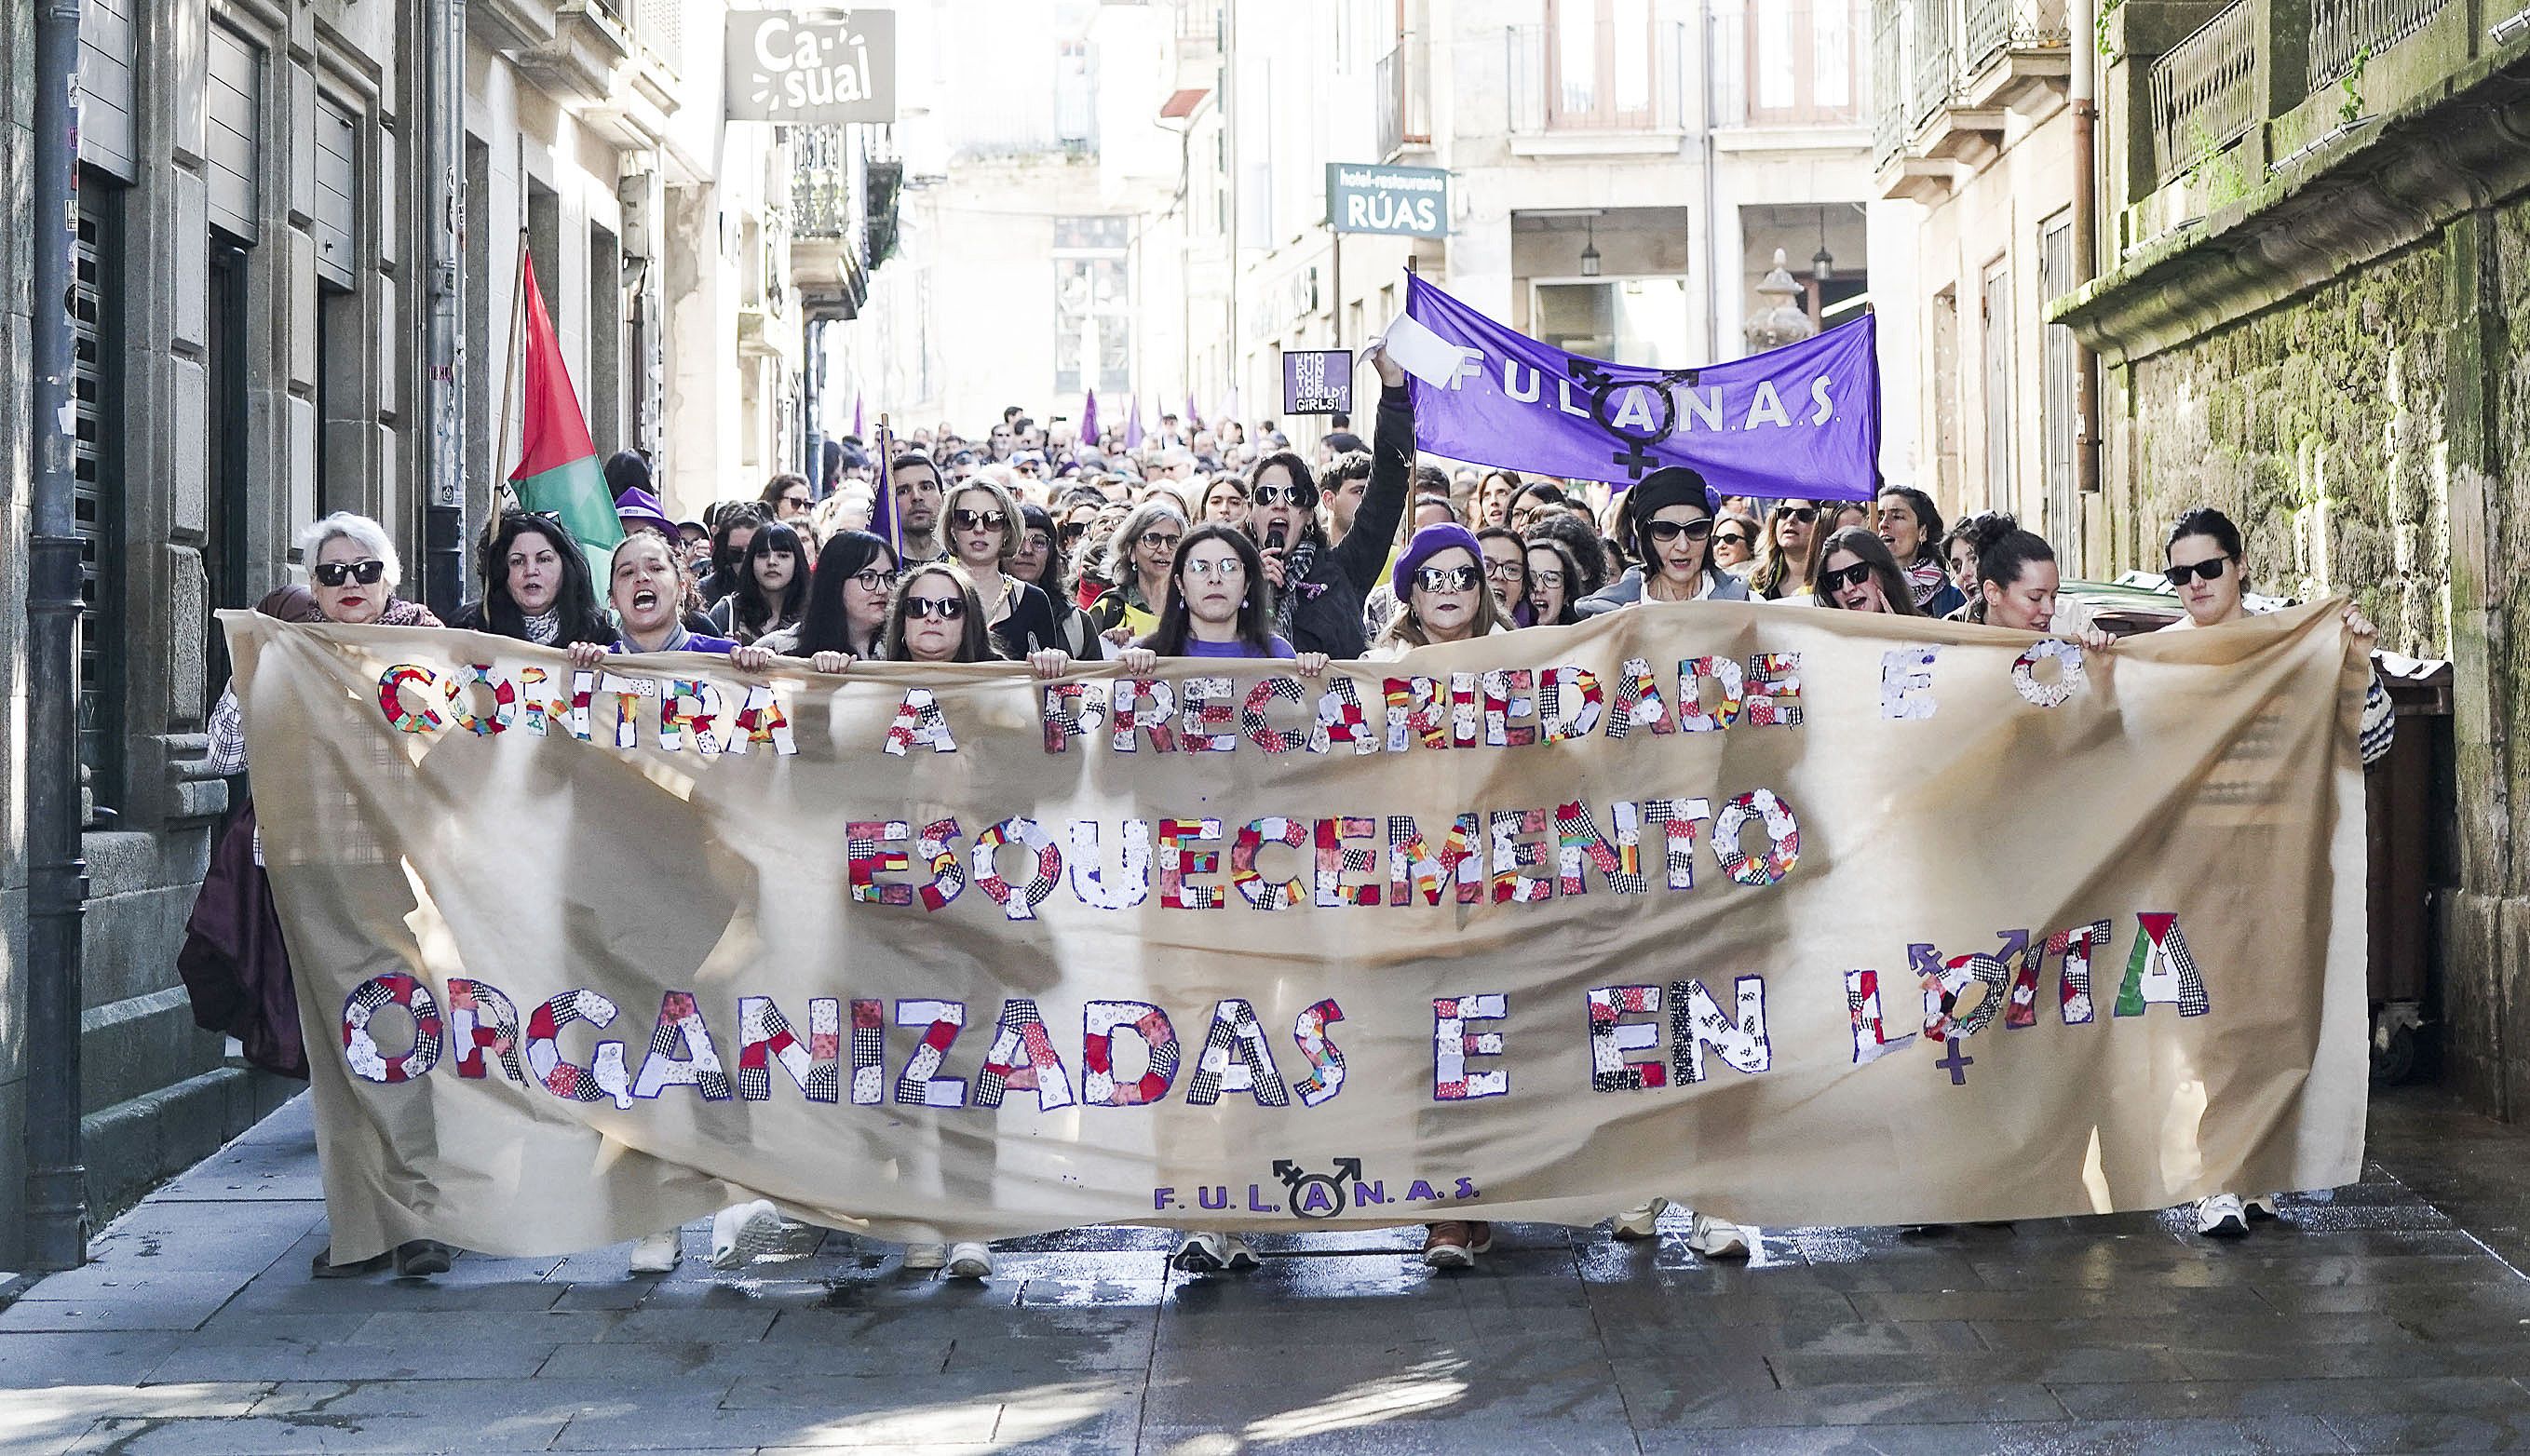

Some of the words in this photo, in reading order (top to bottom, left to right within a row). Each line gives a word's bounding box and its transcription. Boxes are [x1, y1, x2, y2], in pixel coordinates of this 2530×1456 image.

[1347, 190, 1437, 231] RÚAS
[1294, 352, 1325, 365] WHO
[1295, 364, 1325, 380] RUN
[1295, 375, 1324, 389] THE
[1295, 384, 1347, 401] WORLD?
[1296, 398, 1341, 411] GIRLS!
[377, 664, 799, 755] CONTRA
[883, 688, 957, 755] A
[1043, 651, 1806, 755] PRECARIEDADE
[1880, 644, 1941, 721] E
[2011, 639, 2083, 708] O
[846, 788, 1802, 921] ESQUECEMENTO
[344, 972, 1346, 1111] ORGANIZADAS
[1433, 992, 1509, 1100] E
[1587, 975, 1771, 1093] EN
